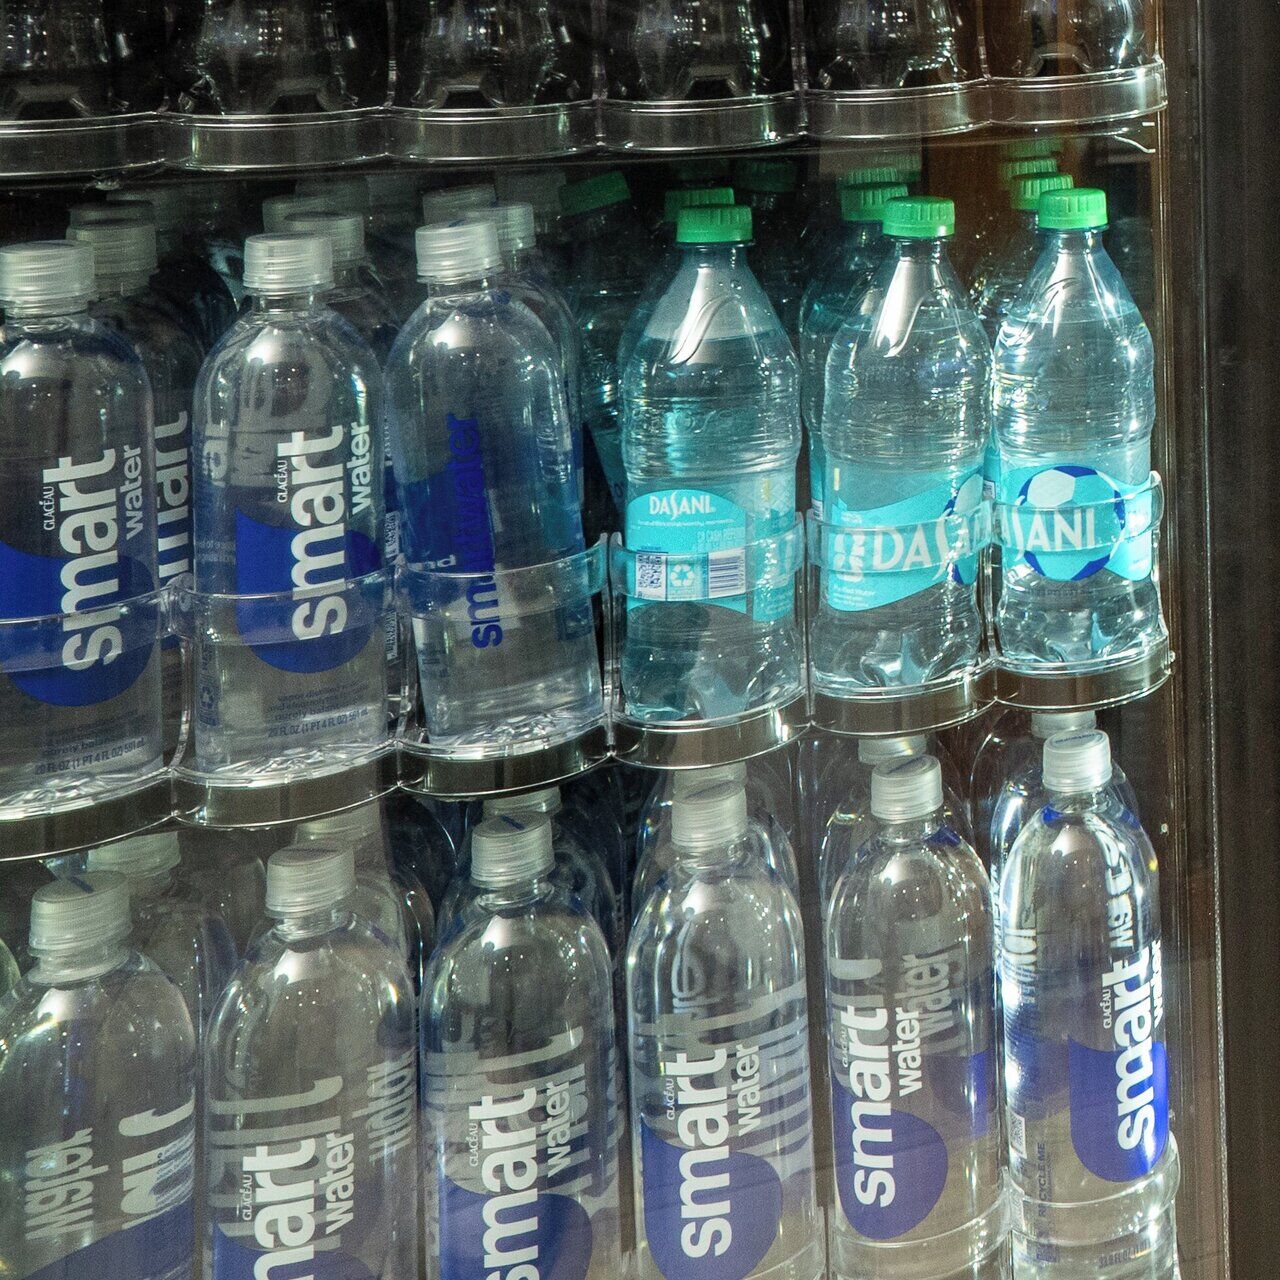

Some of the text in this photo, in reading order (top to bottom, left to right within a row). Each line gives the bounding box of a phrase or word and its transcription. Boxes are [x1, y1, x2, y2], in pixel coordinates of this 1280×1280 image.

[43, 486, 56, 532] GLACÉAU
[43, 444, 143, 671] smart water
[291, 422, 371, 641] smart water
[648, 494, 717, 521] DASANI
[666, 1043, 761, 1258] smart water
[842, 1004, 925, 1208] smart water
[1101, 947, 1155, 1152] smart
